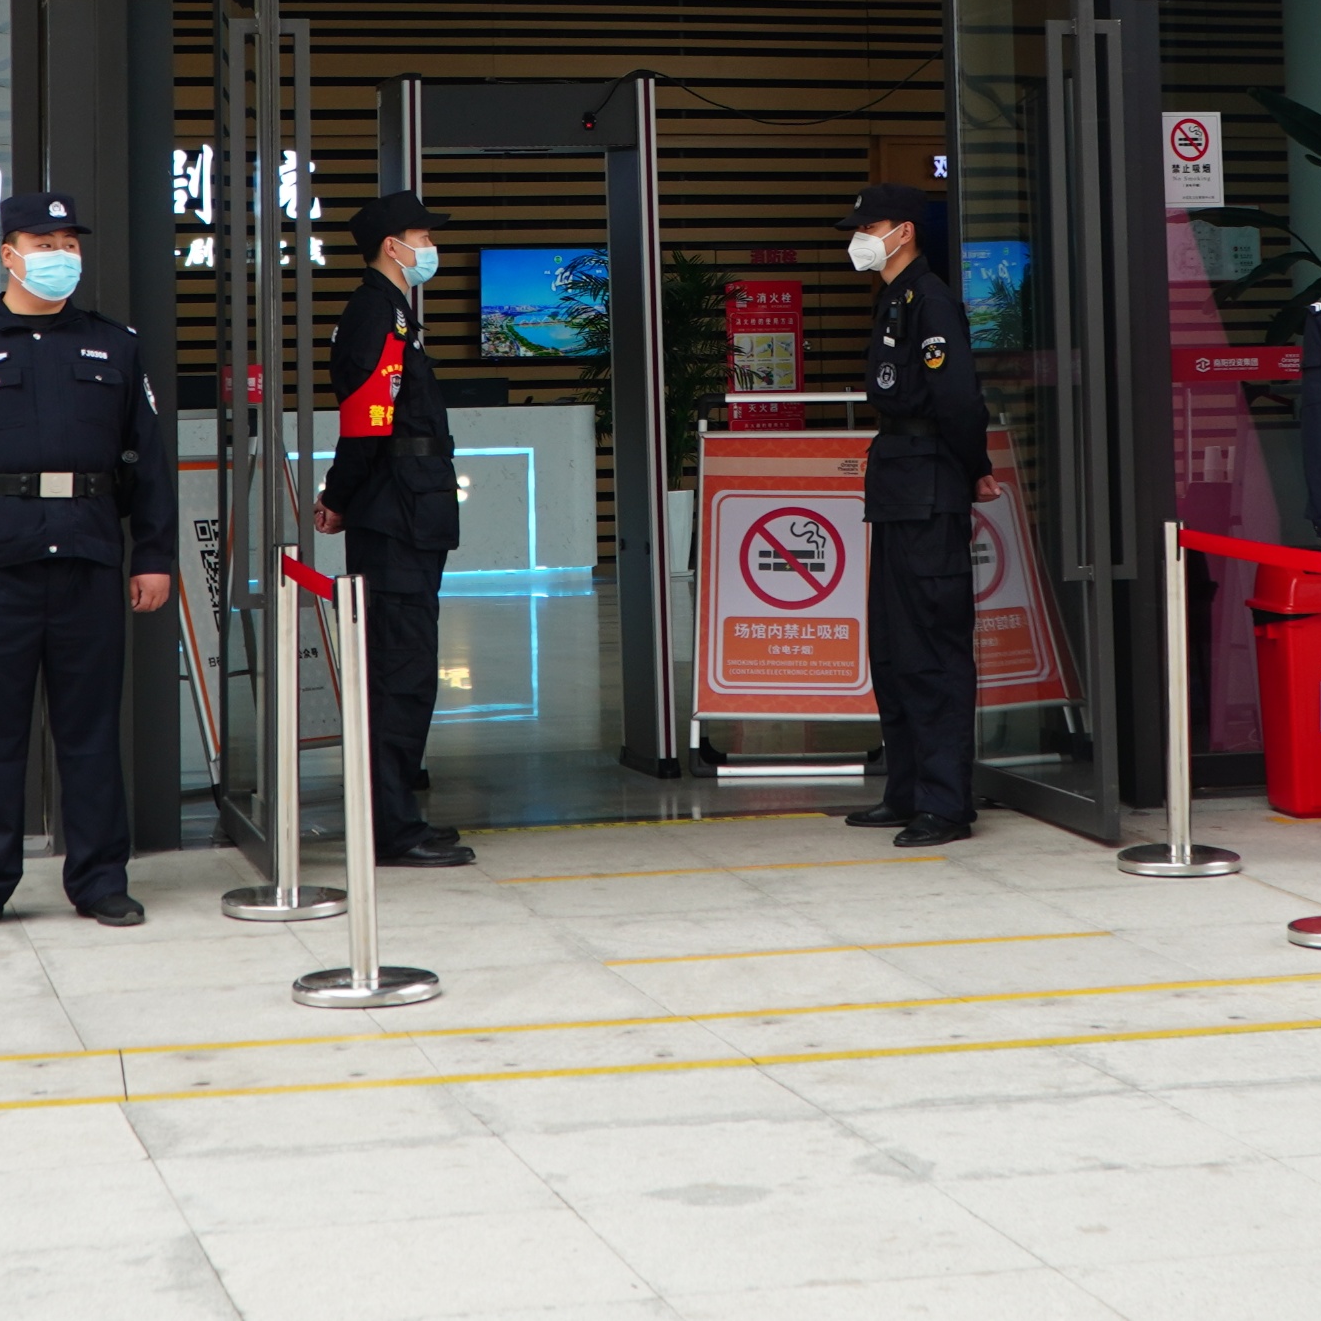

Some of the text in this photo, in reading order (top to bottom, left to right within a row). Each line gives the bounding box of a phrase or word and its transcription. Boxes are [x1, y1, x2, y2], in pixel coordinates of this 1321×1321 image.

[1172, 164, 1211, 174] 禁止吸烟
[757, 293, 792, 303] 消火栓
[734, 623, 850, 640] 场馆内禁止吸烟
